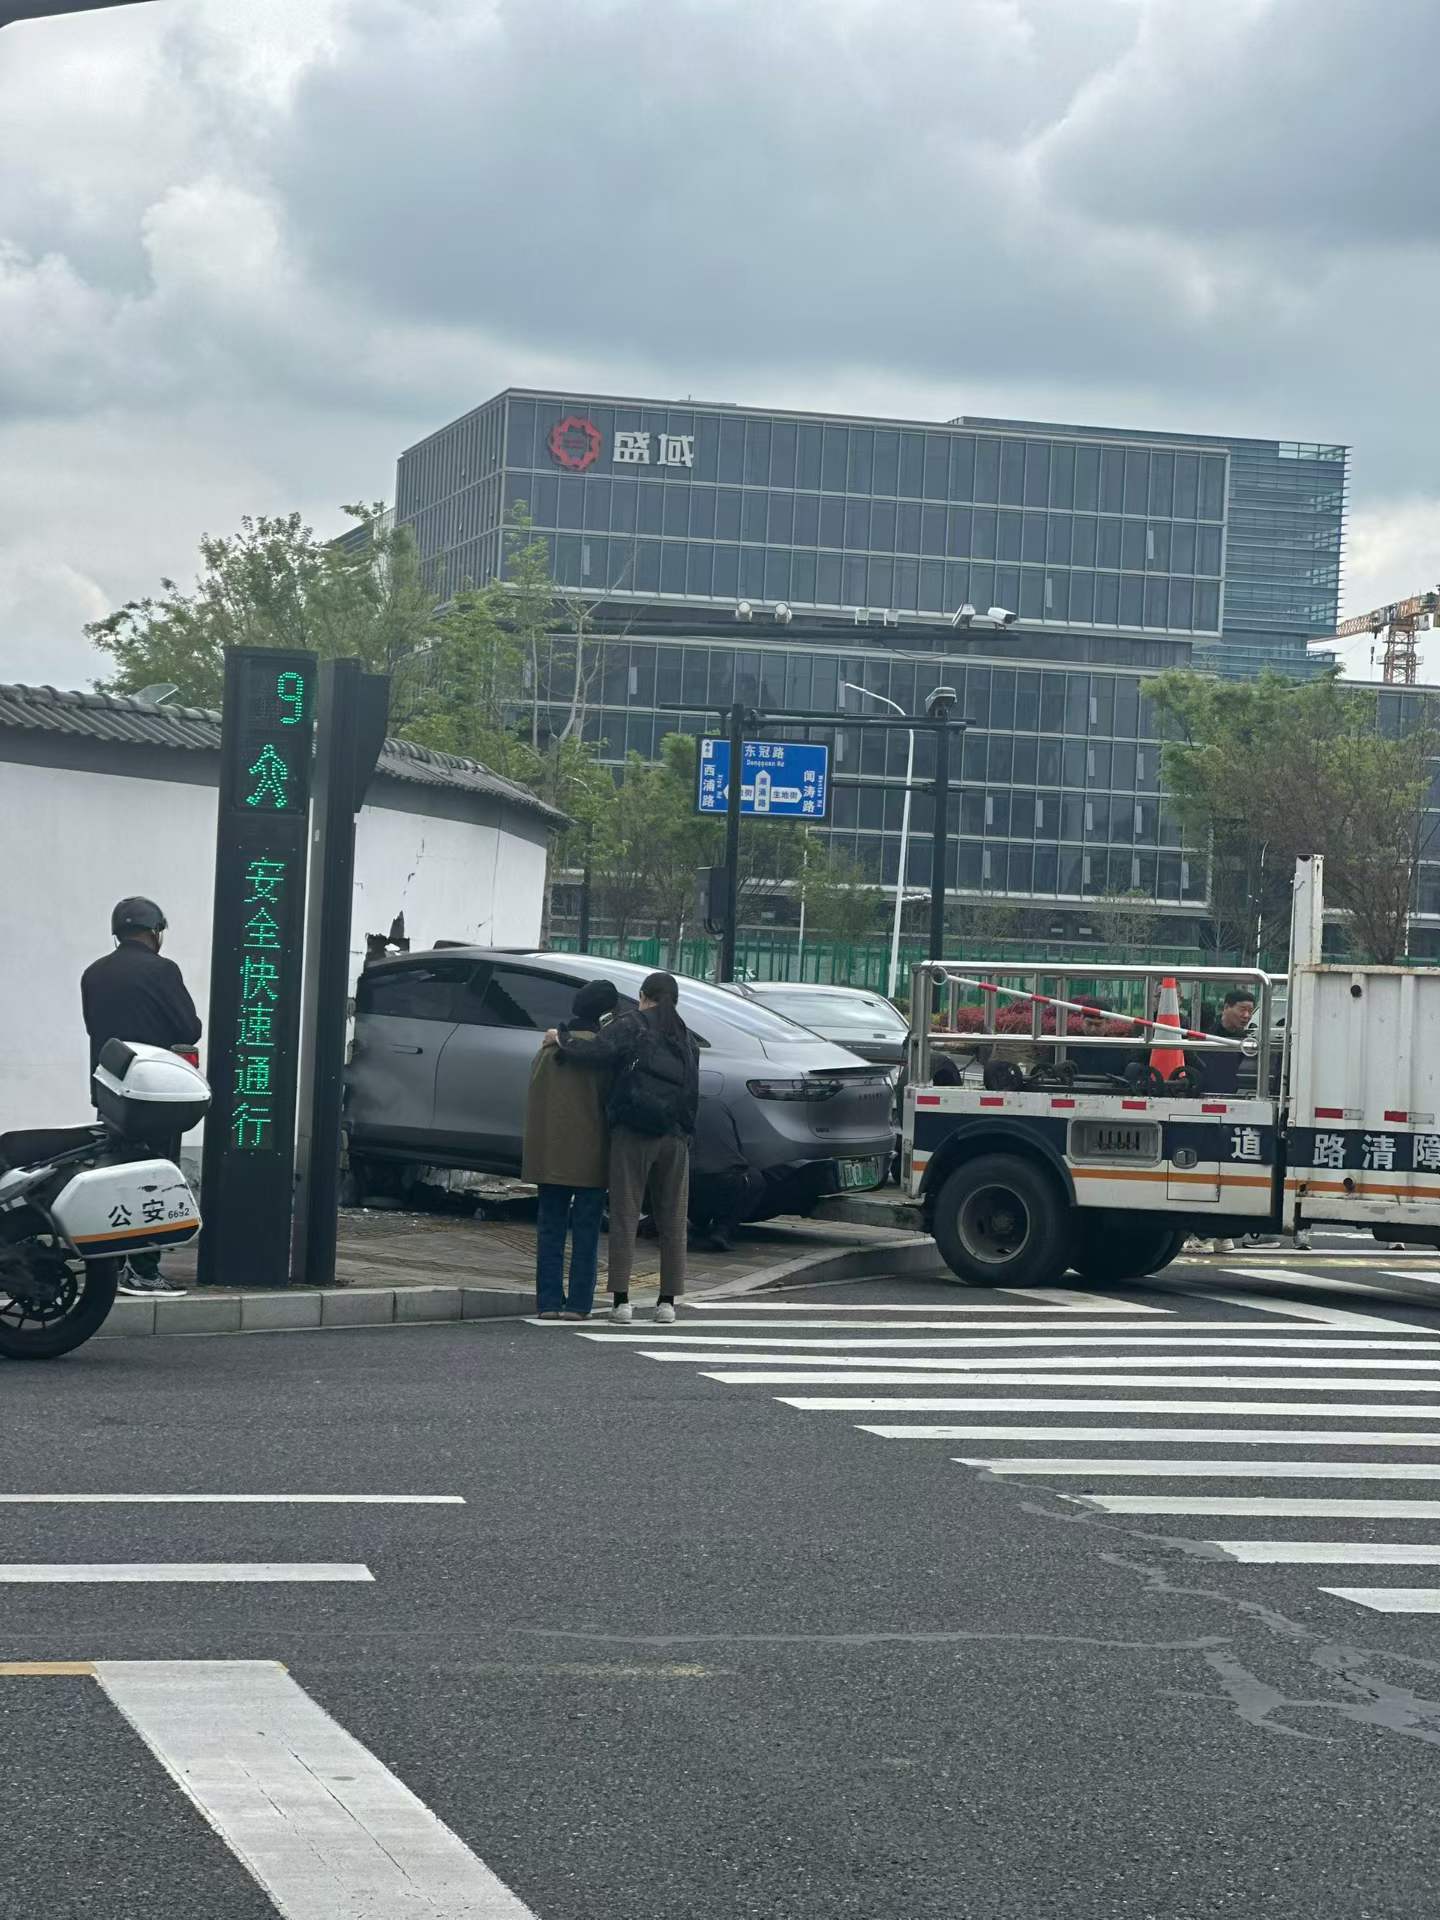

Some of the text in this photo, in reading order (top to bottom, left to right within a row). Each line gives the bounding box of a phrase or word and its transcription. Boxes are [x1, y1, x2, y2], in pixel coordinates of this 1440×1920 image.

[613, 431, 695, 468] 盛域
[277, 670, 304, 725] 9
[744, 744, 785, 760] 东冠路
[702, 764, 716, 808] 西浦路
[231, 857, 287, 1147] 安全快速通行
[107, 1198, 165, 1228] 公安
